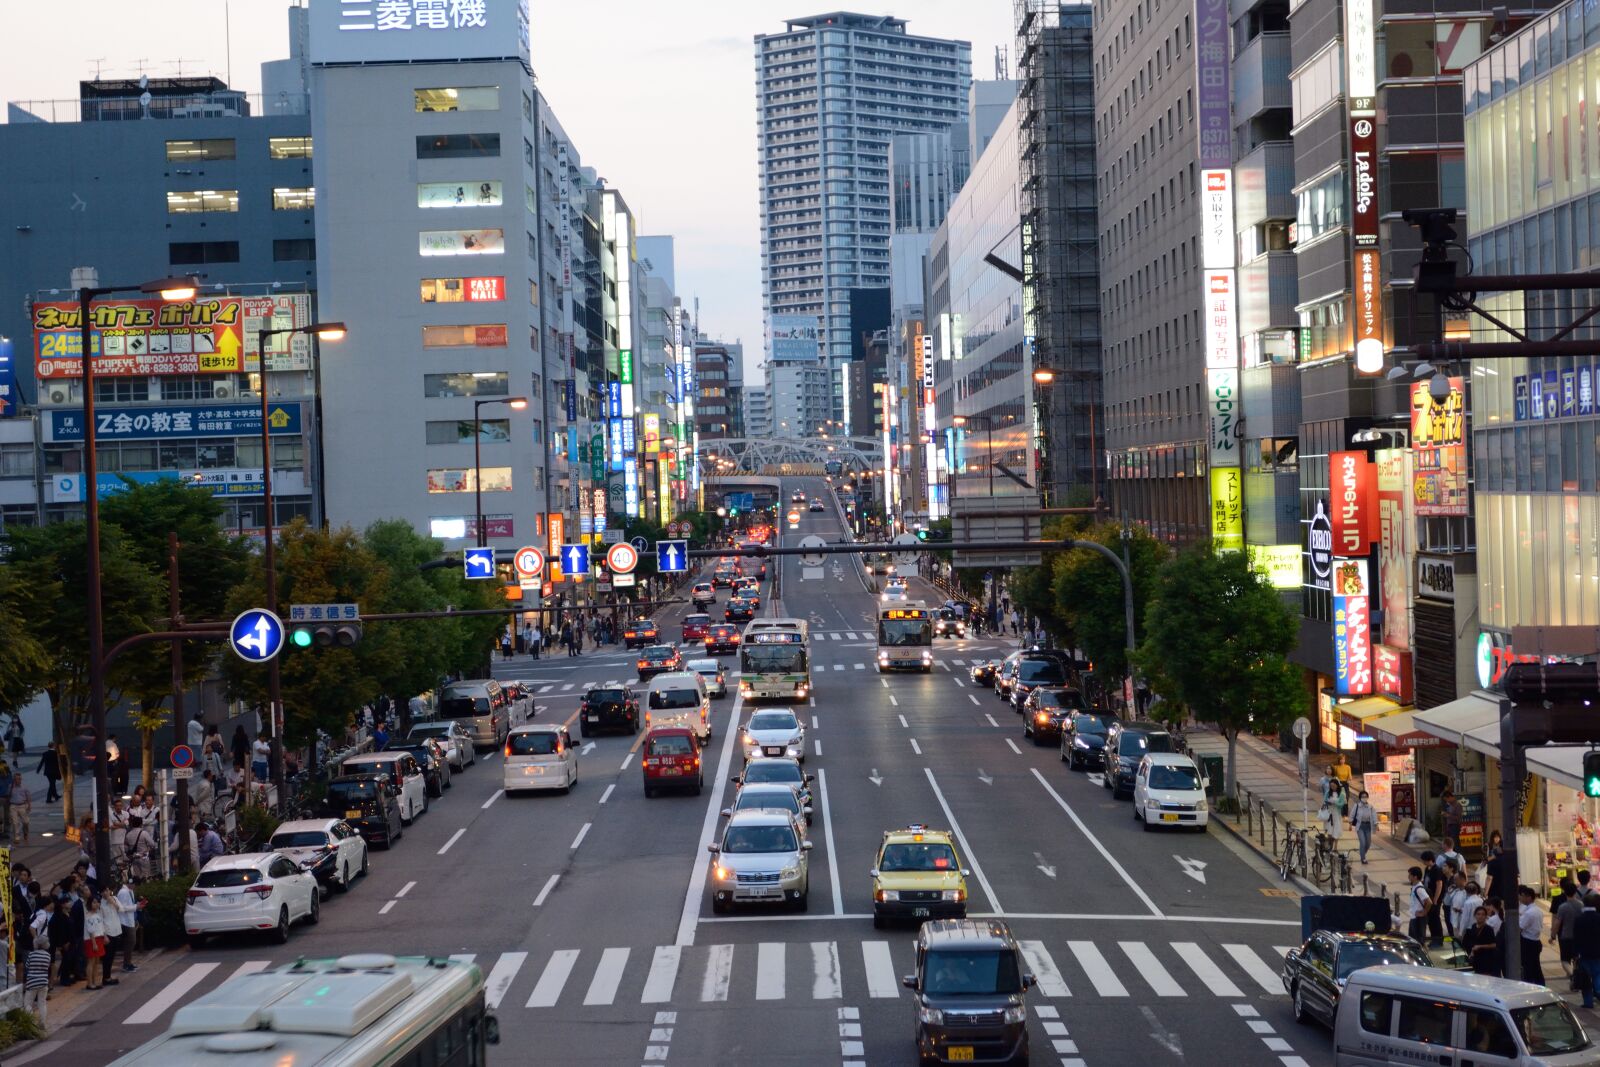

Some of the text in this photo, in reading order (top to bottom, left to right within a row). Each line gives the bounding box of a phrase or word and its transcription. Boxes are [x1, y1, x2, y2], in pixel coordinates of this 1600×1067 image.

[340, 0, 487, 30] 三菱電機
[1356, 98, 1370, 109] 9F
[160, 301, 239, 325] ポパイ
[1214, 300, 1228, 360] 証明写真
[41, 335, 67, 356] 24
[201, 356, 236, 367] 徒歩1分
[97, 412, 192, 433] Z会の教室
[198, 421, 232, 431] 梅田教室
[646, 432, 658, 448] P
[1227, 472, 1238, 523] ストレッチ
[1342, 456, 1360, 551] カメラのナニワ
[1216, 500, 1226, 532] 専門店
[614, 552, 630, 564] 40
[292, 606, 357, 619] 時差信号
[1347, 597, 1370, 692] チケットスーパー
